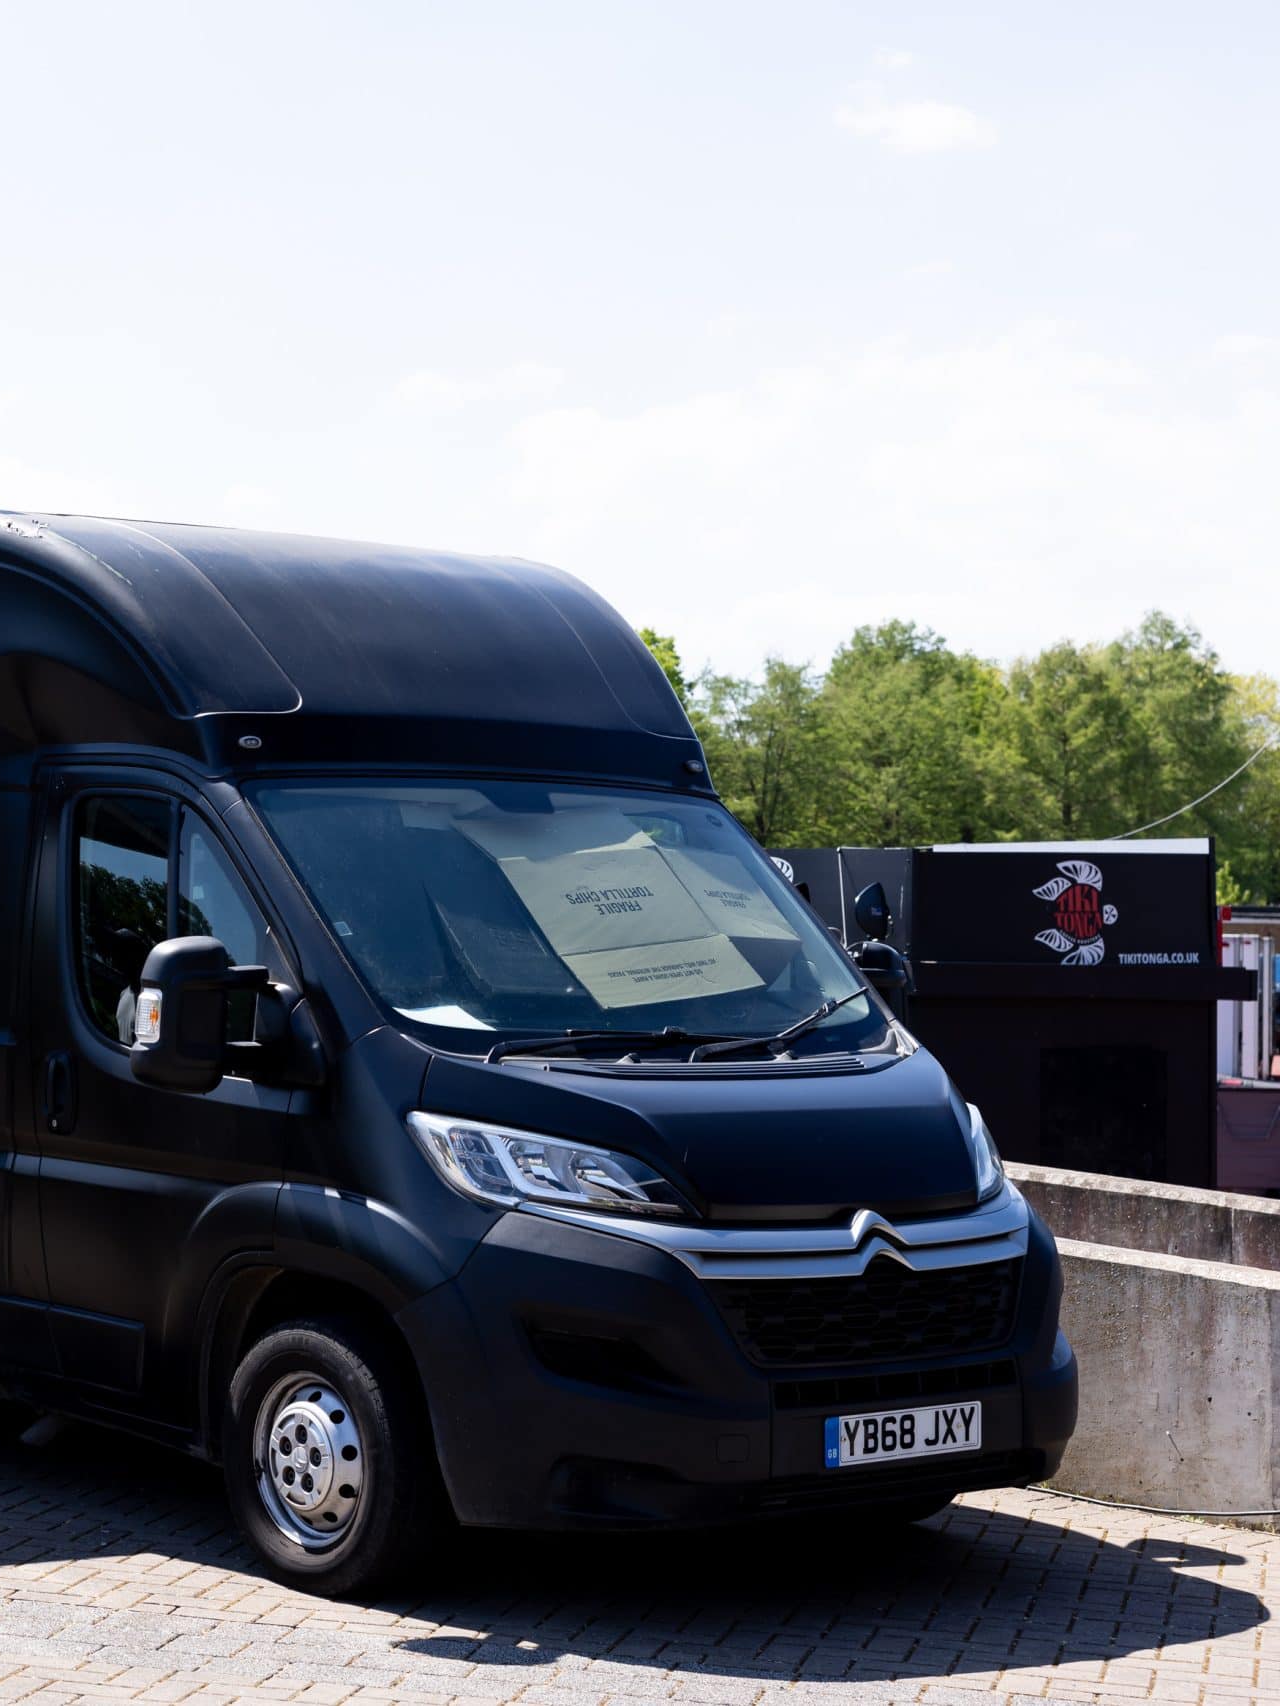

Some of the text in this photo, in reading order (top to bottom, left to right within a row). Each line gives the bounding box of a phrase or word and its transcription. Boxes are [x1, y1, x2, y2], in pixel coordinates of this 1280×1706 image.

[565, 886, 654, 905] TORTILLA CHIPS
[1056, 884, 1099, 912] TIKI
[594, 900, 642, 915] FRAGILE
[1054, 911, 1102, 939] TONGA
[1118, 951, 1200, 965] TIKITONGA.CO.UK
[844, 1406, 975, 1457] YB68 JXY
